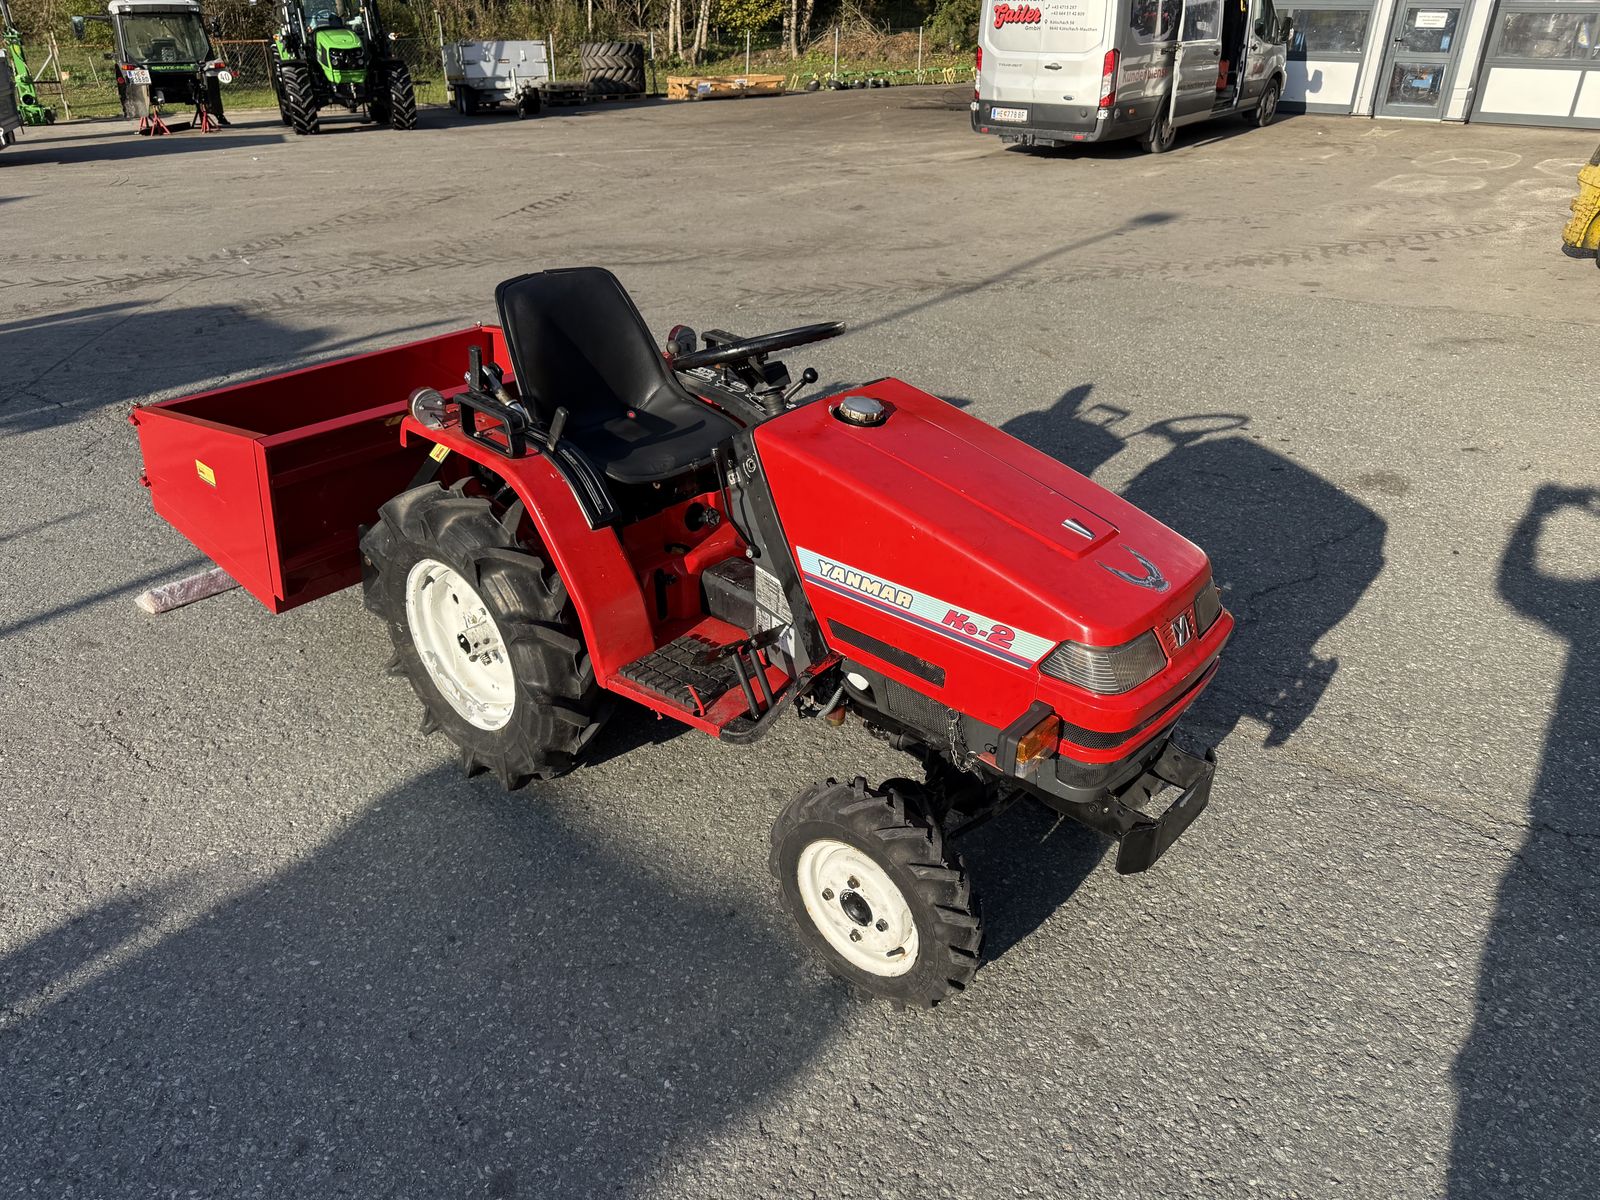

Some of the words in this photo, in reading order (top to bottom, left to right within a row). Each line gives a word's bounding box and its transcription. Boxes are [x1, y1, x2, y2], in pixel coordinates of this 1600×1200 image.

[994, 3, 1041, 29] Gailer
[818, 559, 914, 609] YANMAR
[941, 609, 1016, 650] Ke-2
